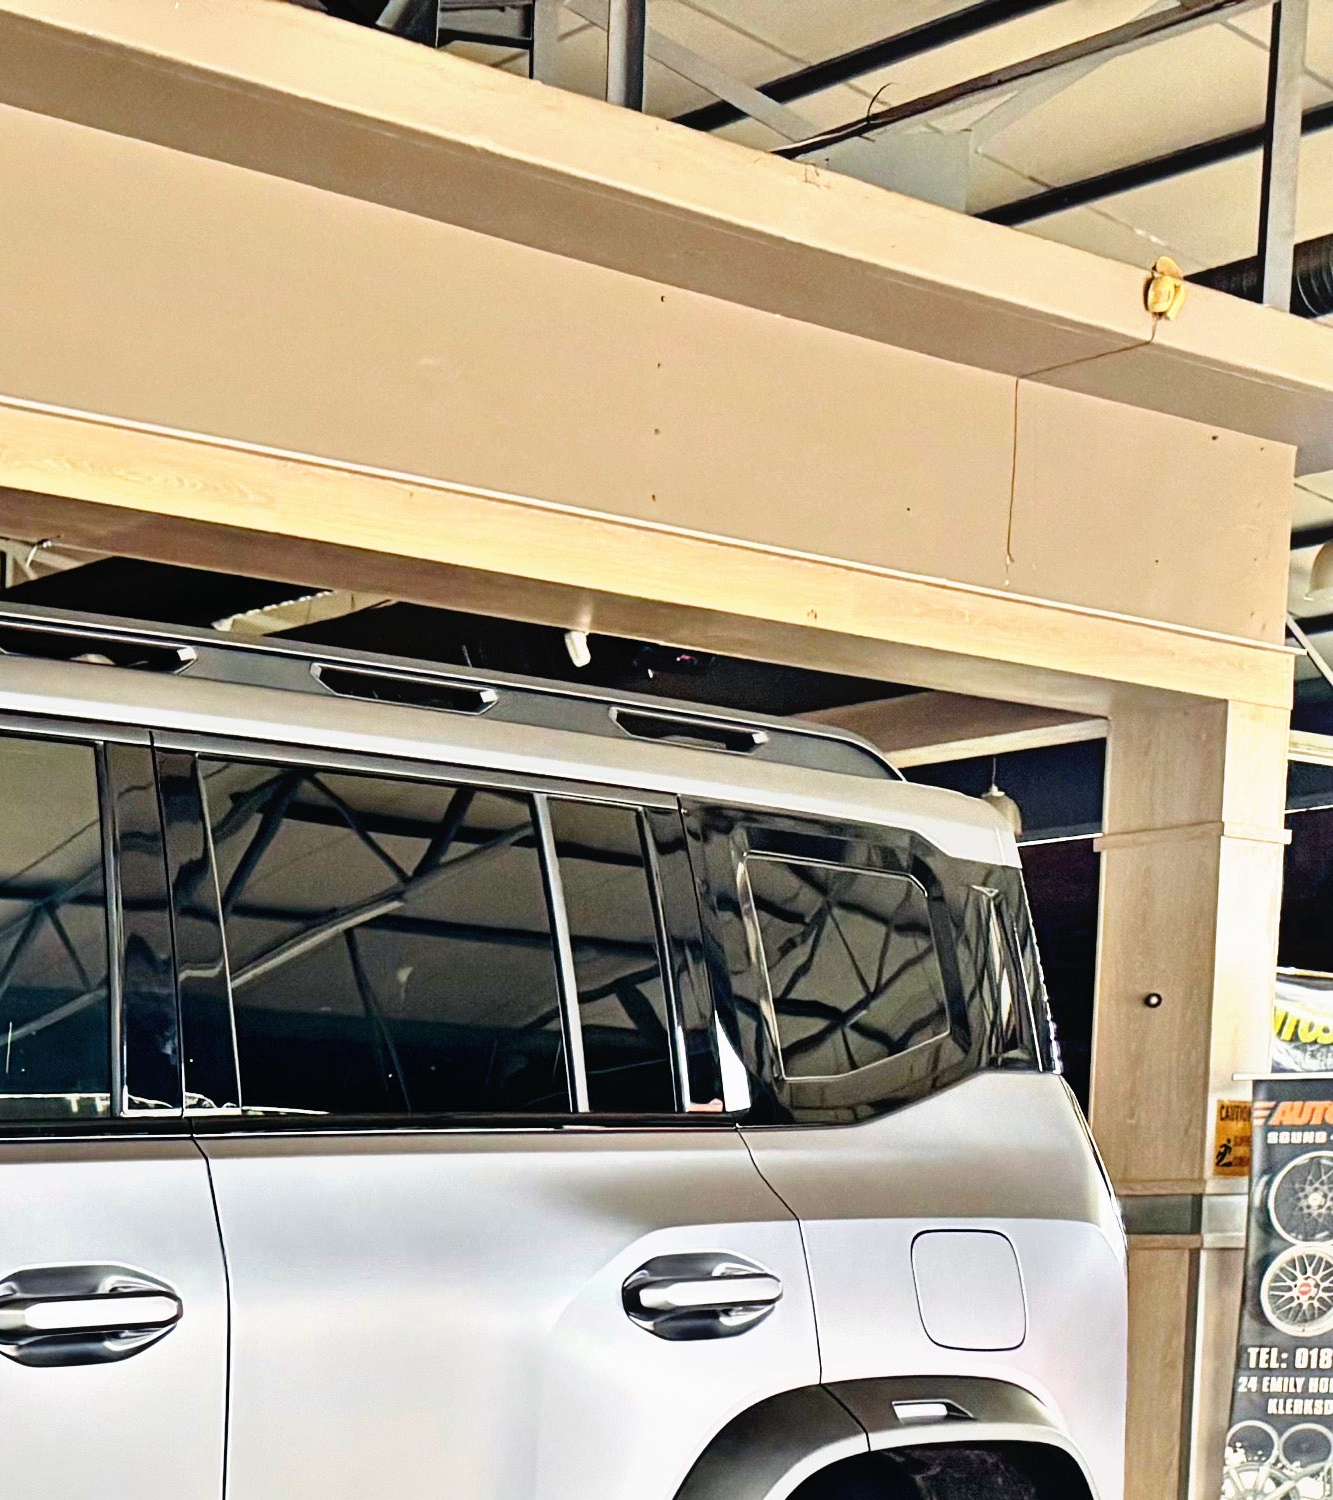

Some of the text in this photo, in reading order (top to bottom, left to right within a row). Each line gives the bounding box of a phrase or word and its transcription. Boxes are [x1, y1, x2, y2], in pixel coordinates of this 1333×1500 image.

[1267, 1131, 1327, 1144] SOUND
[1247, 1347, 1289, 1369] TEL:
[1237, 1376, 1258, 1393] 24
[1261, 1376, 1305, 1393] EMILY
